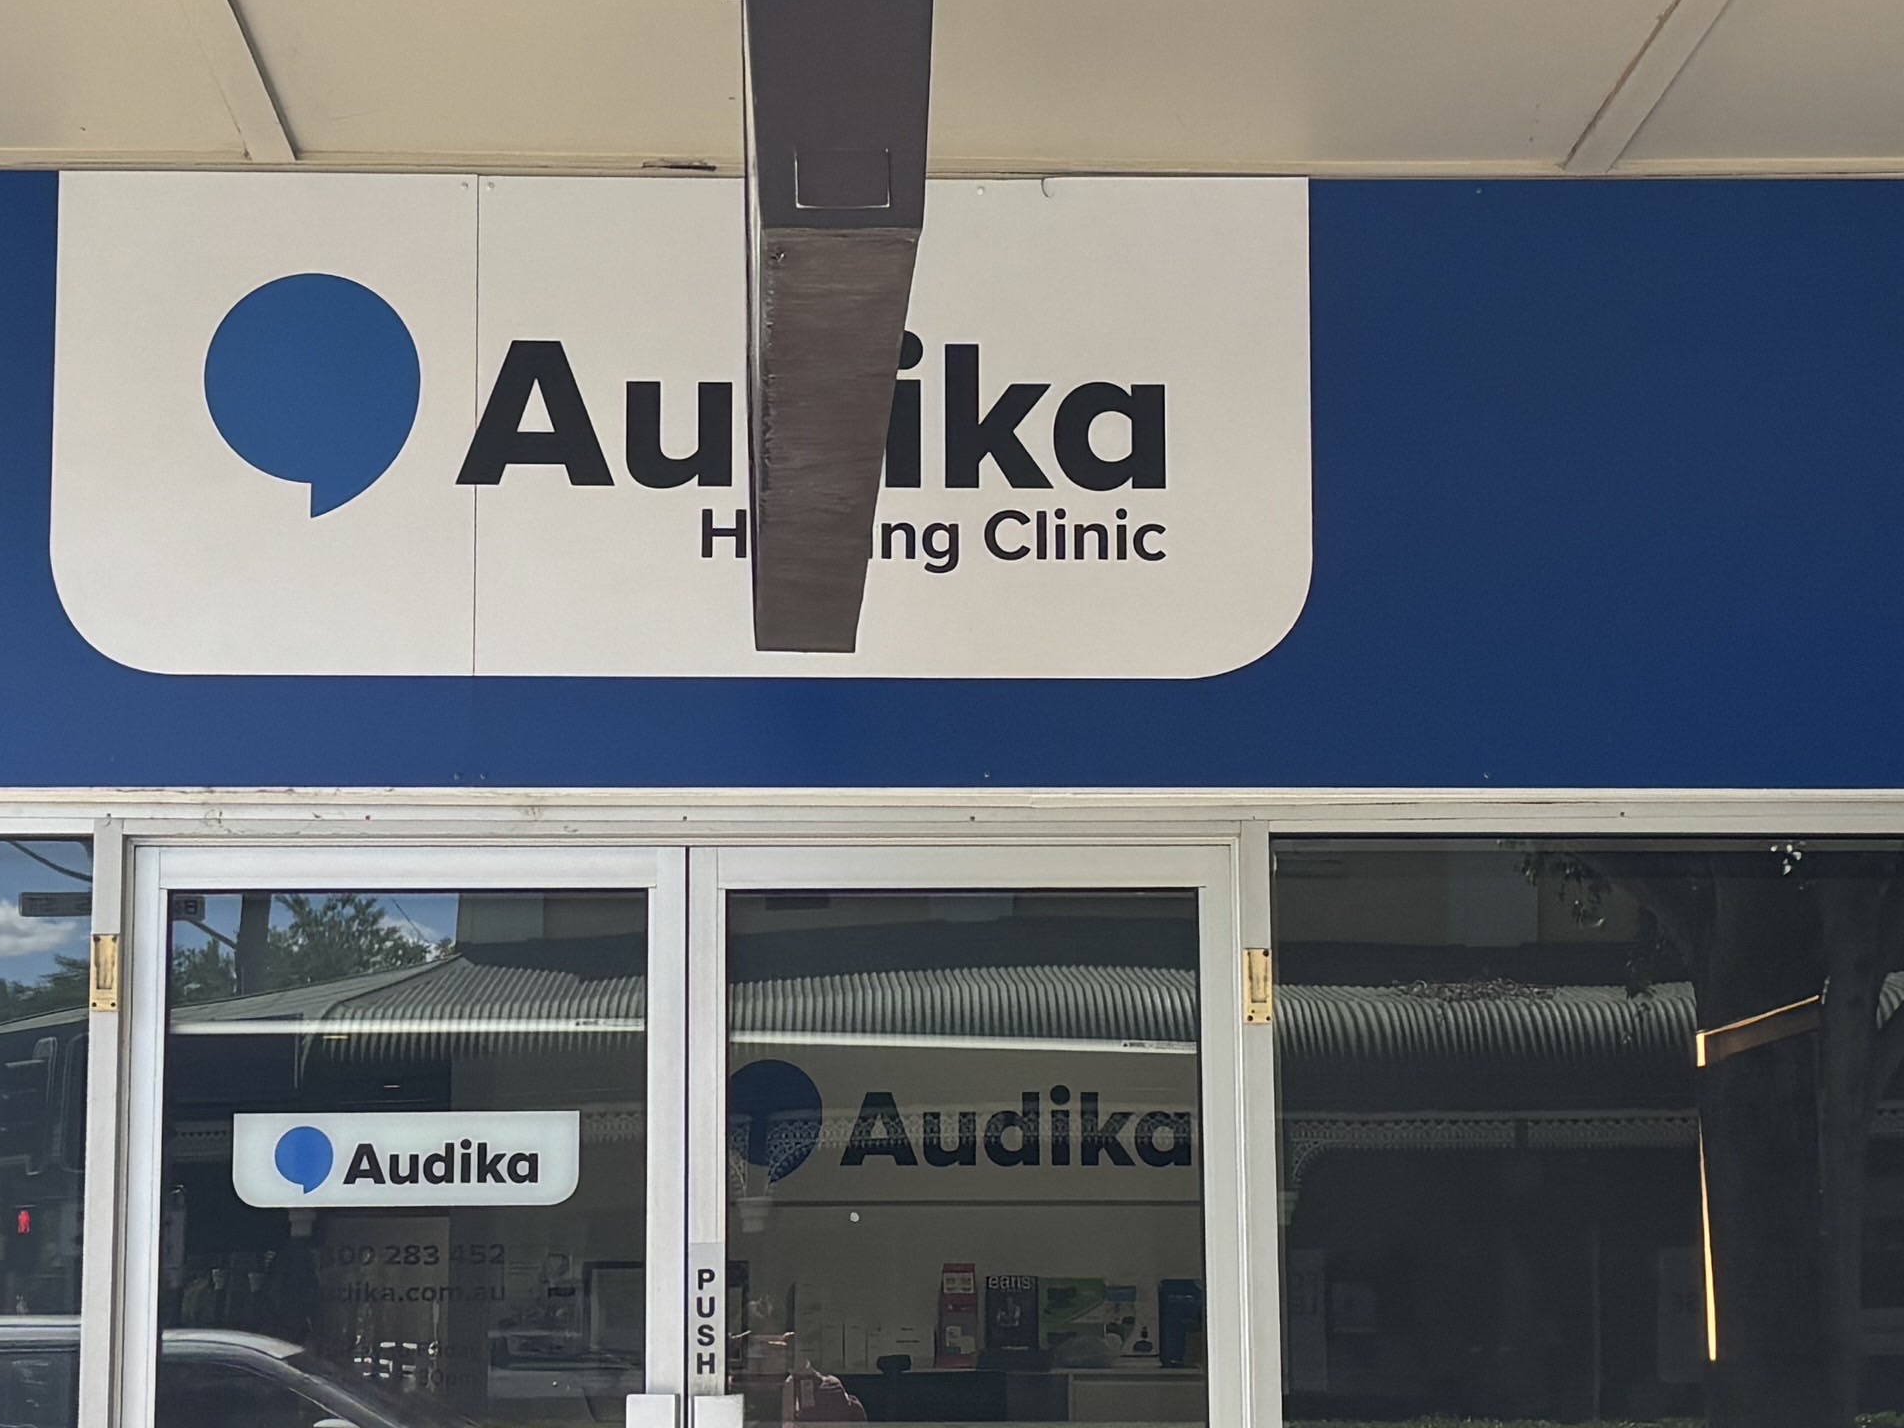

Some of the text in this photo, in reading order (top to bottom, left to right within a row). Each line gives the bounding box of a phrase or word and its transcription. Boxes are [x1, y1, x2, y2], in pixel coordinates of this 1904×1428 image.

[455, 330, 1167, 491] Auika
[982, 508, 1167, 563] Clinic
[840, 1085, 1193, 1167] Audika
[342, 1139, 539, 1185] Audika
[384, 1244, 440, 1266] 283
[449, 1243, 505, 1265] 452
[695, 1269, 716, 1375] PUSH
